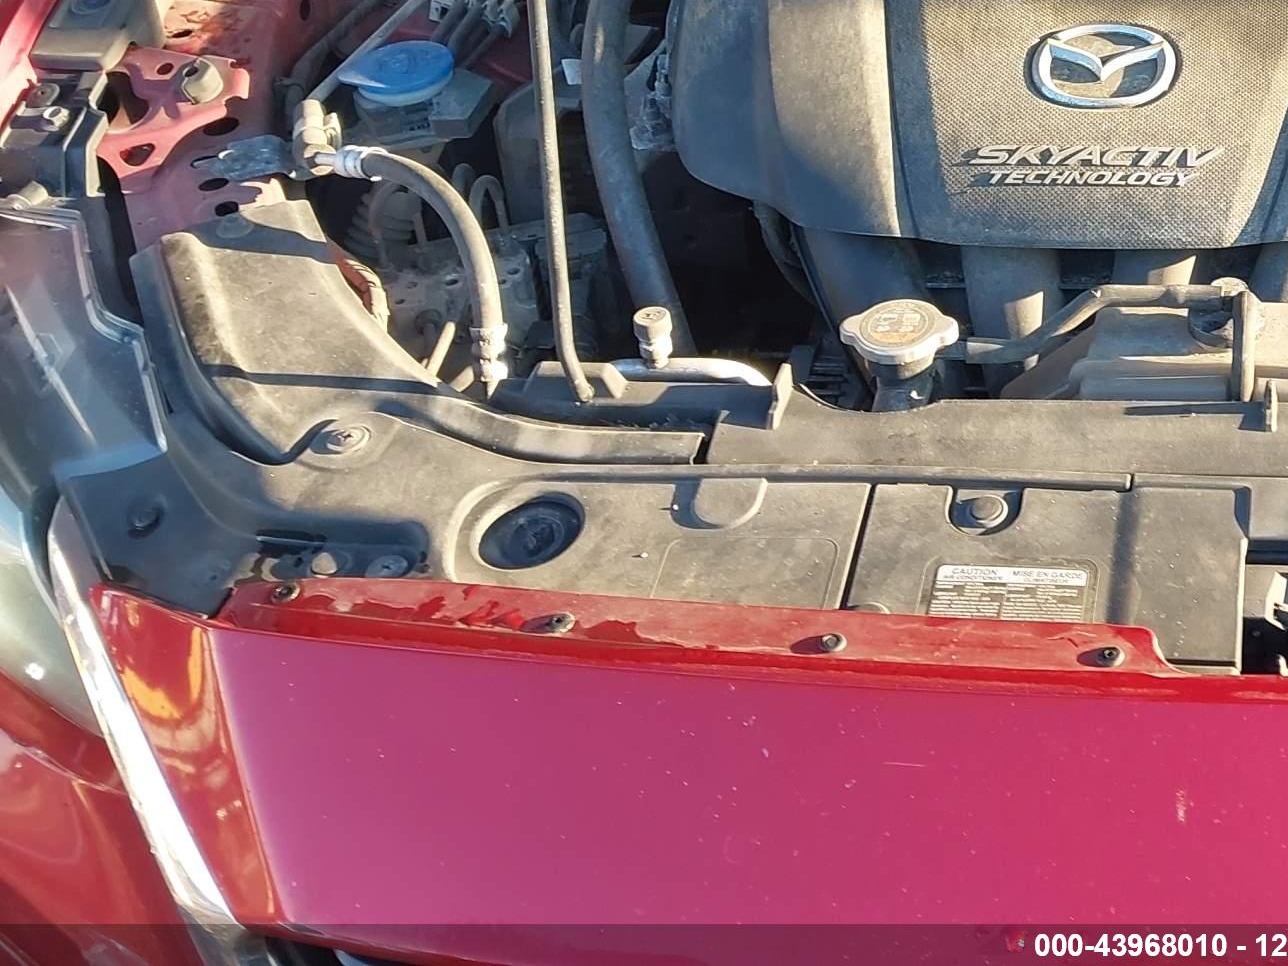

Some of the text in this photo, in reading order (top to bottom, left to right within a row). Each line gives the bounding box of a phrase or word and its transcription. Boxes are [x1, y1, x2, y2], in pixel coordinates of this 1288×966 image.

[968, 144, 1226, 167] SKYACTIV
[988, 169, 1199, 187] TECHNOLOGY
[951, 567, 999, 576] CAUTION
[1012, 569, 1034, 578] MISE
[1051, 571, 1084, 580] GARDE
